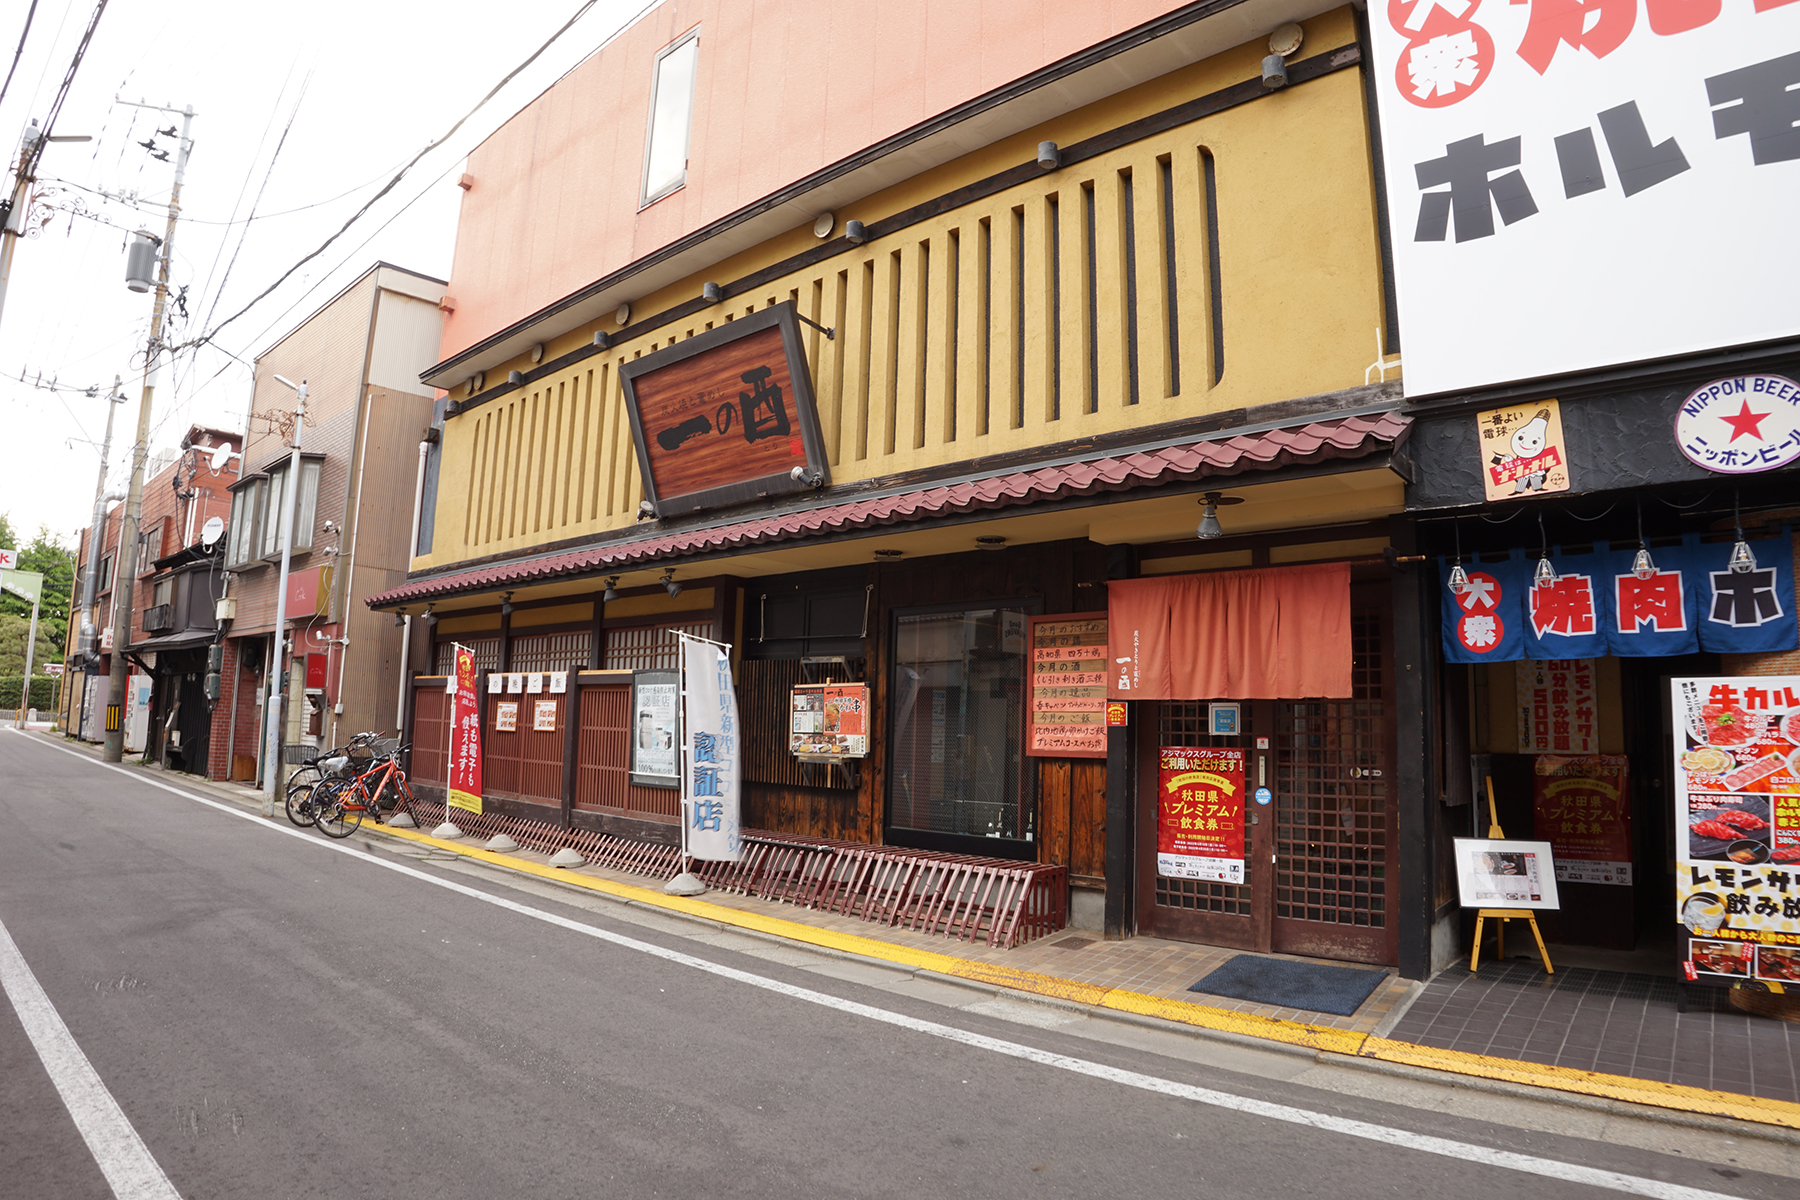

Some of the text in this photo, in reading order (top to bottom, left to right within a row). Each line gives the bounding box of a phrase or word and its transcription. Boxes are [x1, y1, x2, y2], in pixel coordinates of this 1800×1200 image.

[1683, 378, 1746, 418] NIPPON
[657, 365, 791, 451] 一の酉
[1481, 411, 1524, 426] 一番よい
[1498, 455, 1557, 483] ナショナル
[1464, 577, 1496, 647] 大衆
[1039, 623, 1099, 635] 今月のおすすめ
[1037, 661, 1081, 673] 今月の酒
[1116, 656, 1132, 690] 一の酉
[642, 695, 671, 707] 認証店
[1709, 684, 1800, 712] 牛カル
[1040, 713, 1092, 724] 今月のご飯
[468, 712, 479, 787] 紙も電子も
[1161, 749, 1242, 759] アジマックスグループ全店
[1161, 757, 1243, 772] ご利用いただけます！
[692, 731, 723, 832] 認証店
[1687, 777, 1724, 785] レモンタン
[1181, 789, 1219, 803] 秋田県
[1560, 795, 1603, 808] 秋田県
[1171, 801, 1230, 817] プレミアム
[1549, 806, 1615, 821] プレミアム
[1180, 816, 1219, 831] 飲食券
[1560, 821, 1603, 835] 飲食券
[1691, 866, 1800, 892] レモンサ
